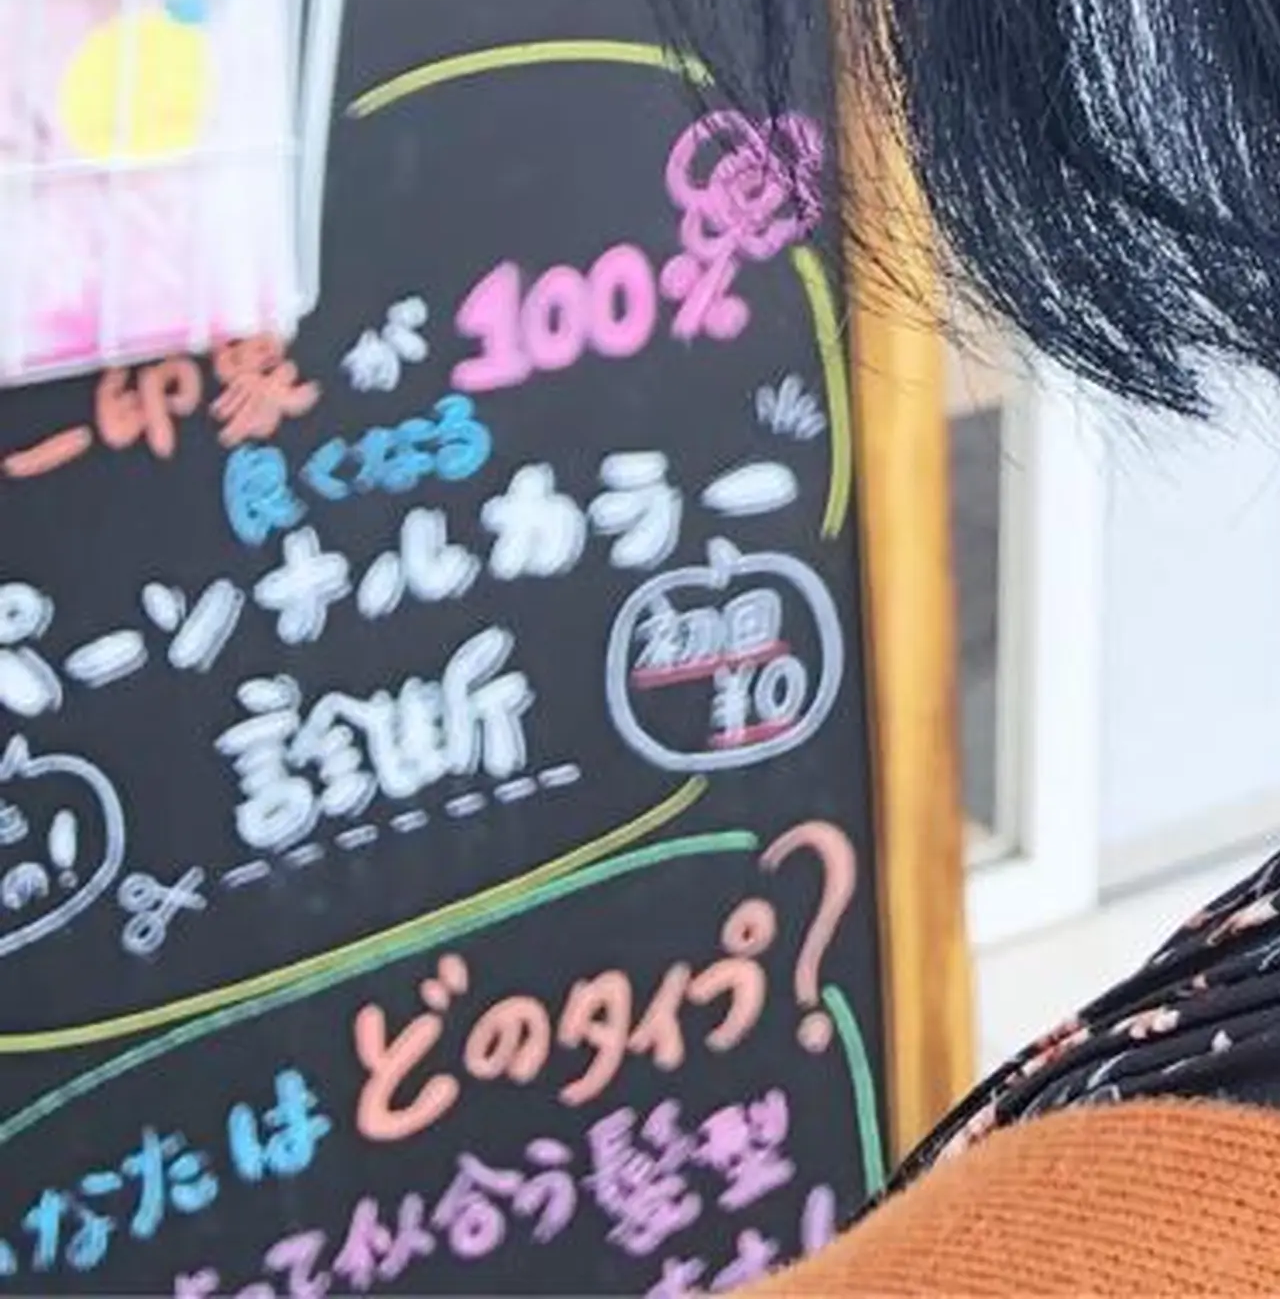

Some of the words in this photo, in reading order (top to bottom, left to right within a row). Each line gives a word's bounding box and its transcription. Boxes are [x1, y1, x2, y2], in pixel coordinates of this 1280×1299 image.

[634, 587, 783, 673] 初回
[213, 625, 536, 849] 診断
[0, 1069, 332, 1276] なたは
